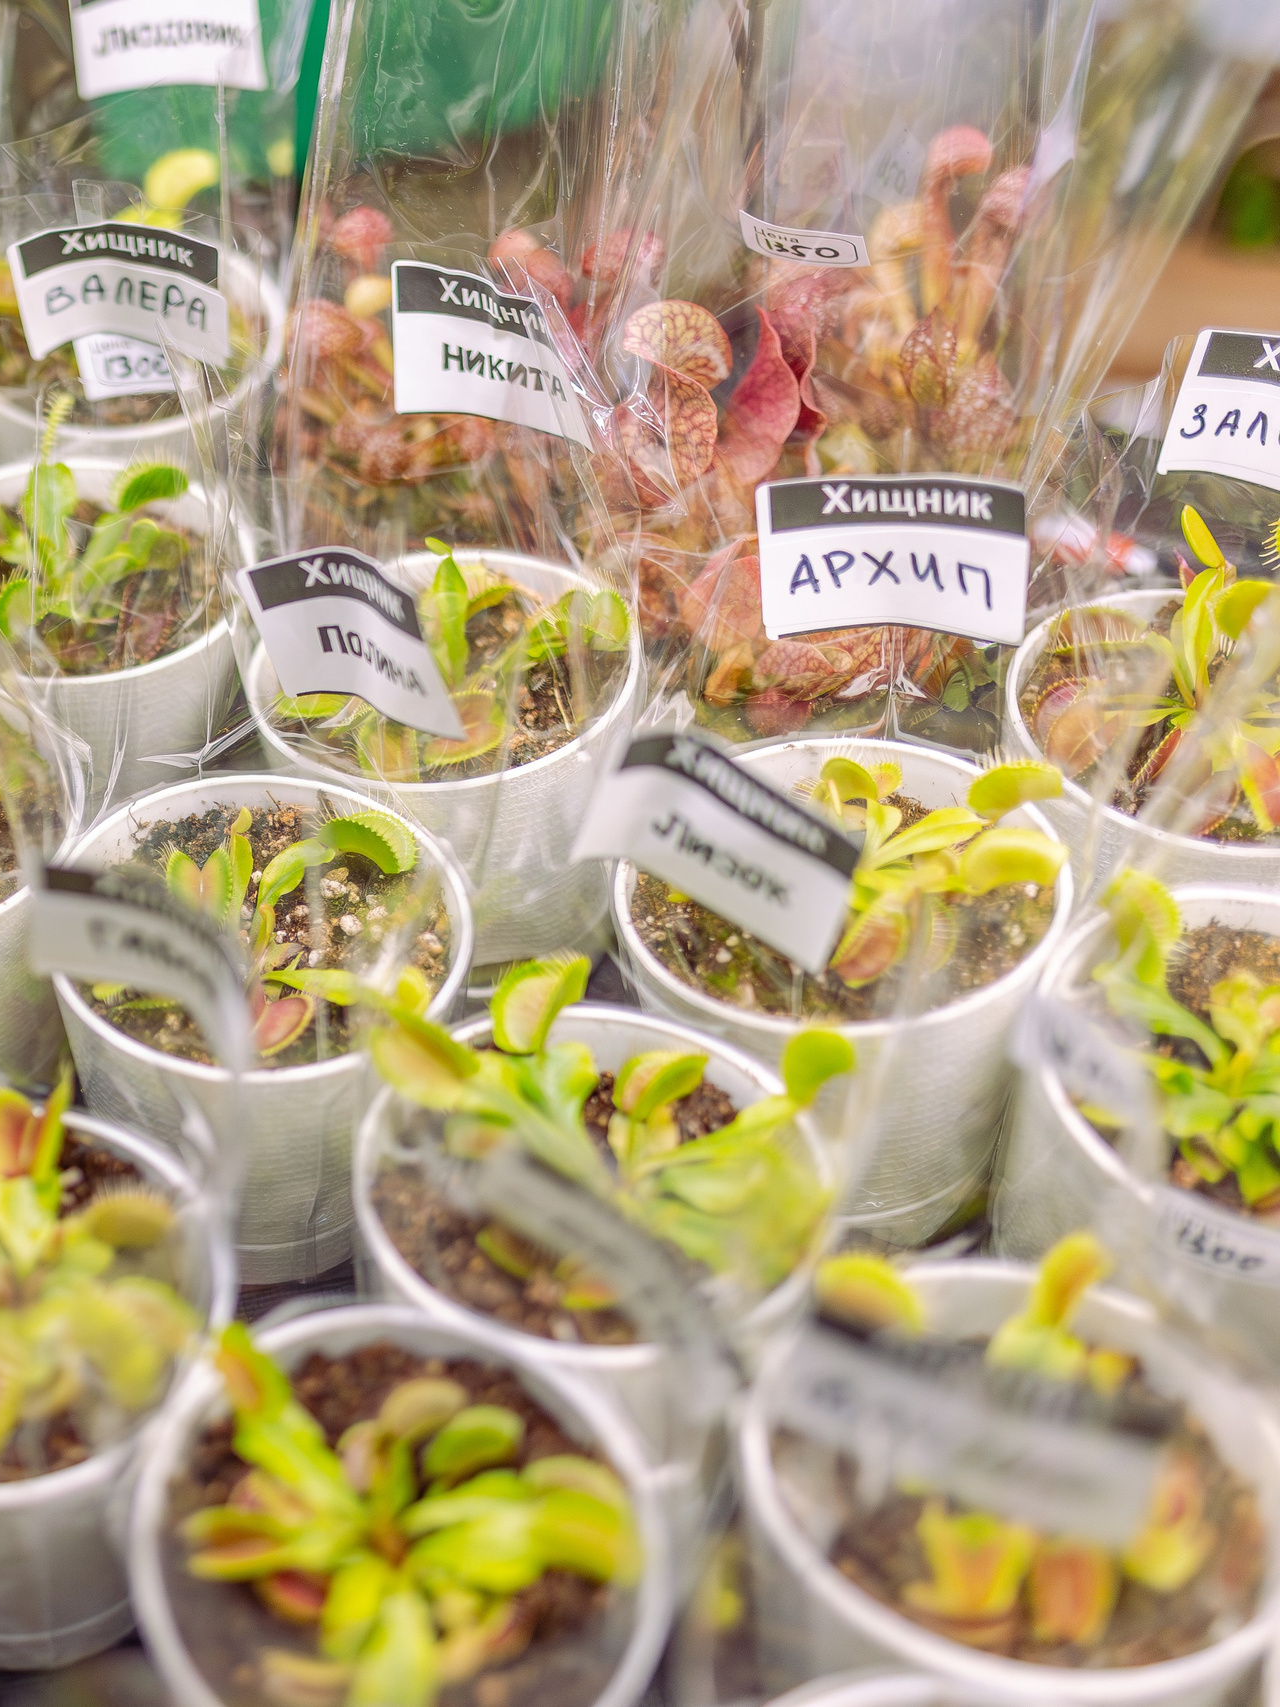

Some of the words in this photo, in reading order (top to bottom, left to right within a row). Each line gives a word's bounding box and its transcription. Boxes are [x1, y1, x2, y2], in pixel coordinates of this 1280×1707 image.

[59, 231, 194, 267] Хищник
[754, 226, 799, 244] Цена
[45, 274, 207, 330] ВАЛЕРА
[1180, 403, 1280, 446] ЗАЛ
[821, 483, 994, 521] Хищник
[298, 557, 406, 622] Хищник
[789, 550, 993, 611] АРХИП
